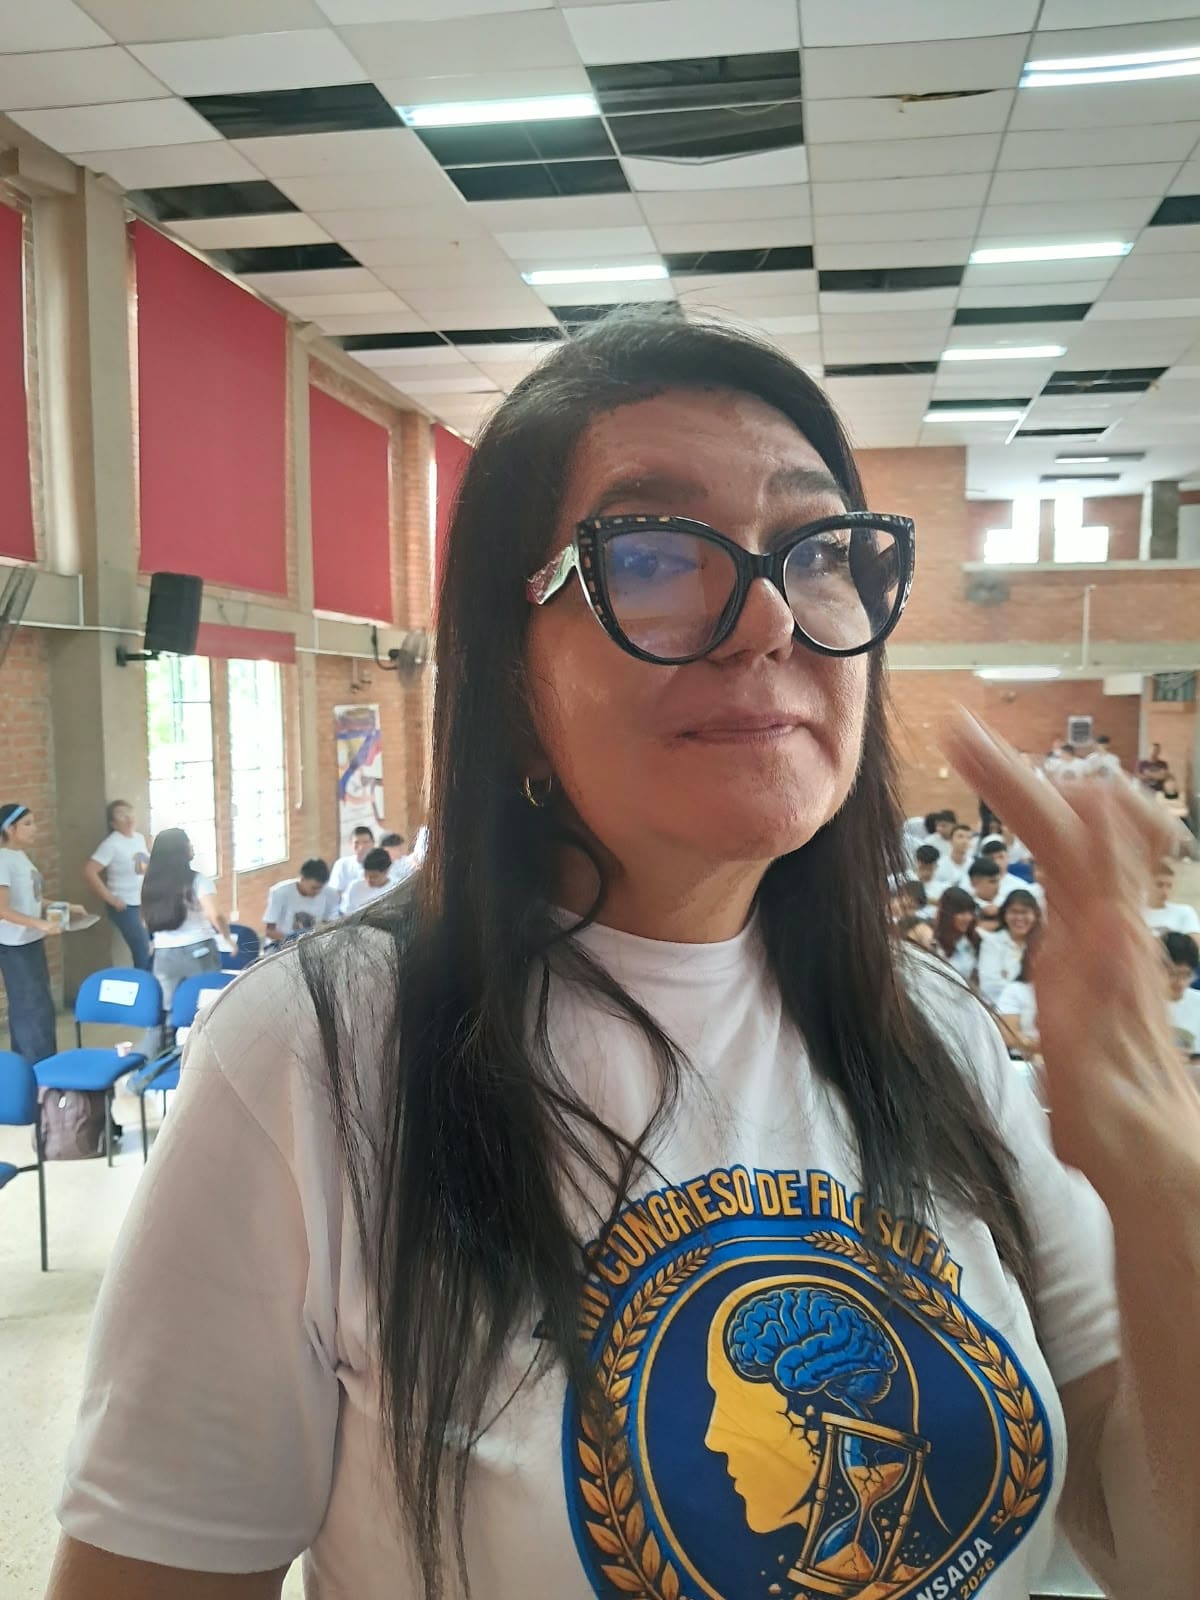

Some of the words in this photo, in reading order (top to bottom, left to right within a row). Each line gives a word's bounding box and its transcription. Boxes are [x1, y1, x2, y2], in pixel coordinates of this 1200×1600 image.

[586, 1168, 754, 1285] CONGRESO
[756, 1173, 803, 1216] DE
[960, 1557, 995, 1600] 2026
